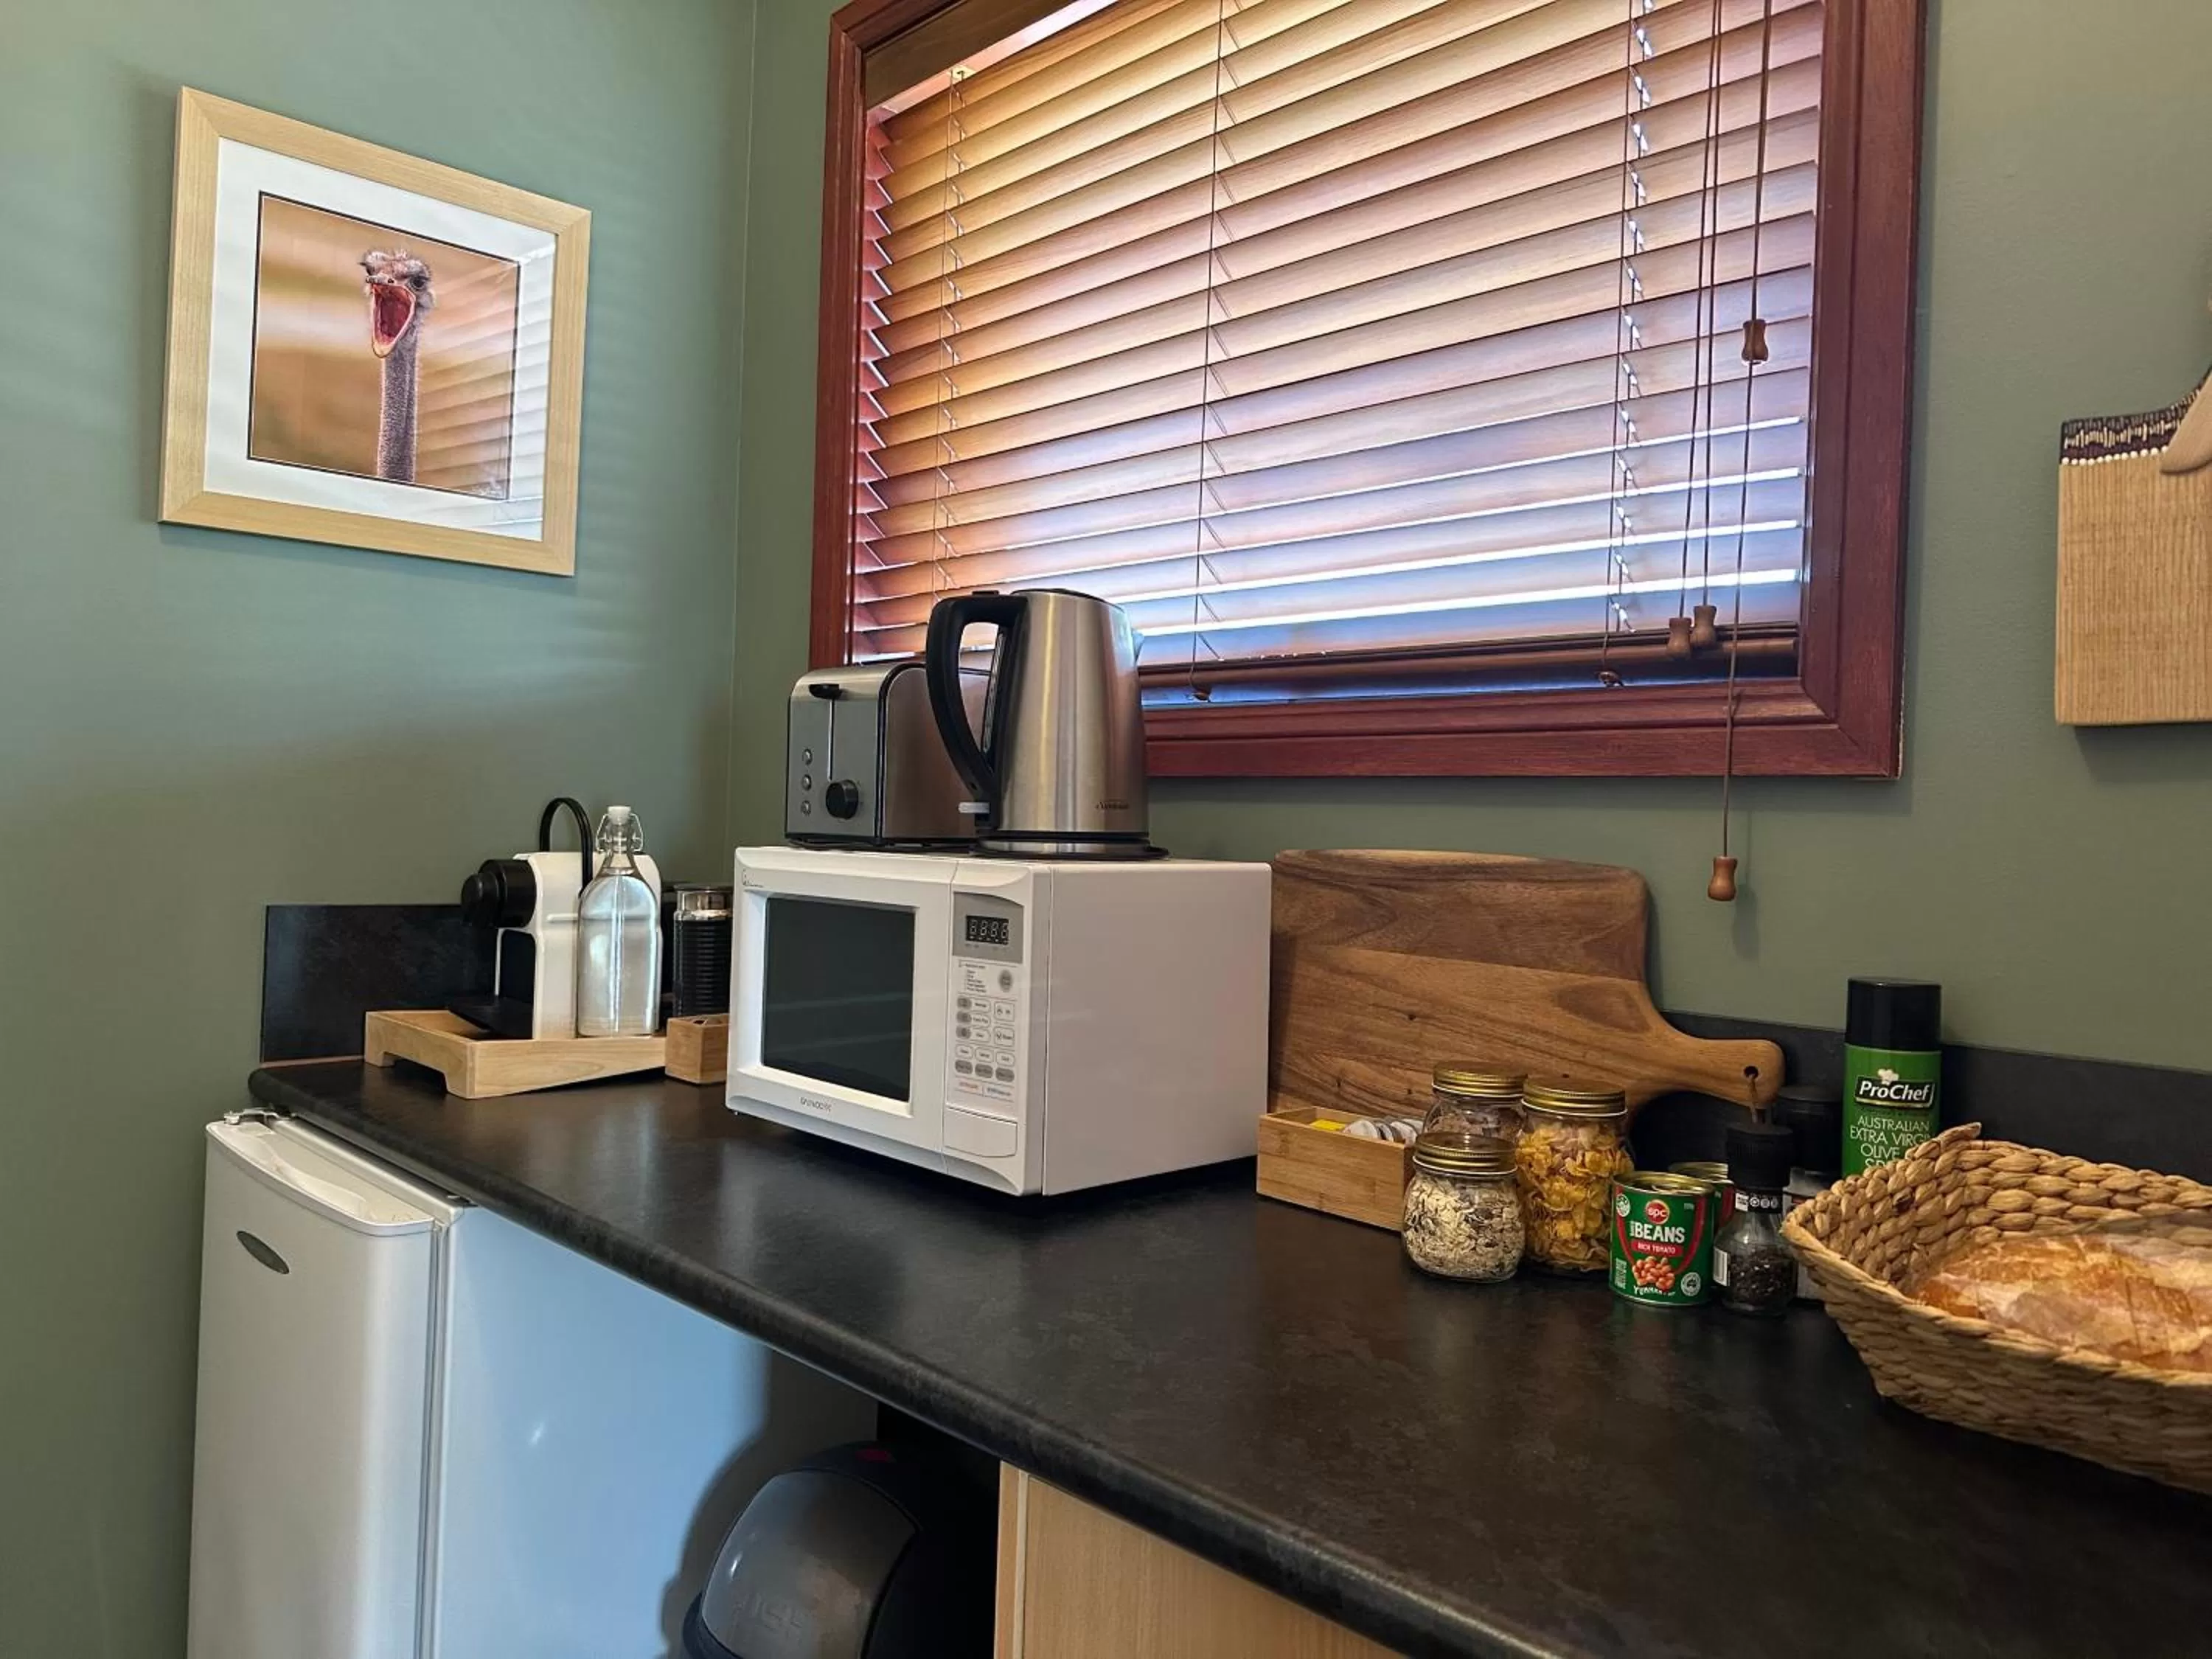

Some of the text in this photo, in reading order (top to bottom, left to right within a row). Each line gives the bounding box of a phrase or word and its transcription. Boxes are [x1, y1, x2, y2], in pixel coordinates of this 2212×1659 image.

[1859, 1080, 1930, 1101] ProChef
[1857, 1116, 1930, 1132] AUSTRALIAN
[1850, 1125, 1888, 1144] EXTRA
[1860, 1143, 1900, 1160] OLIVE
[1635, 1221, 1686, 1244] BEANS
